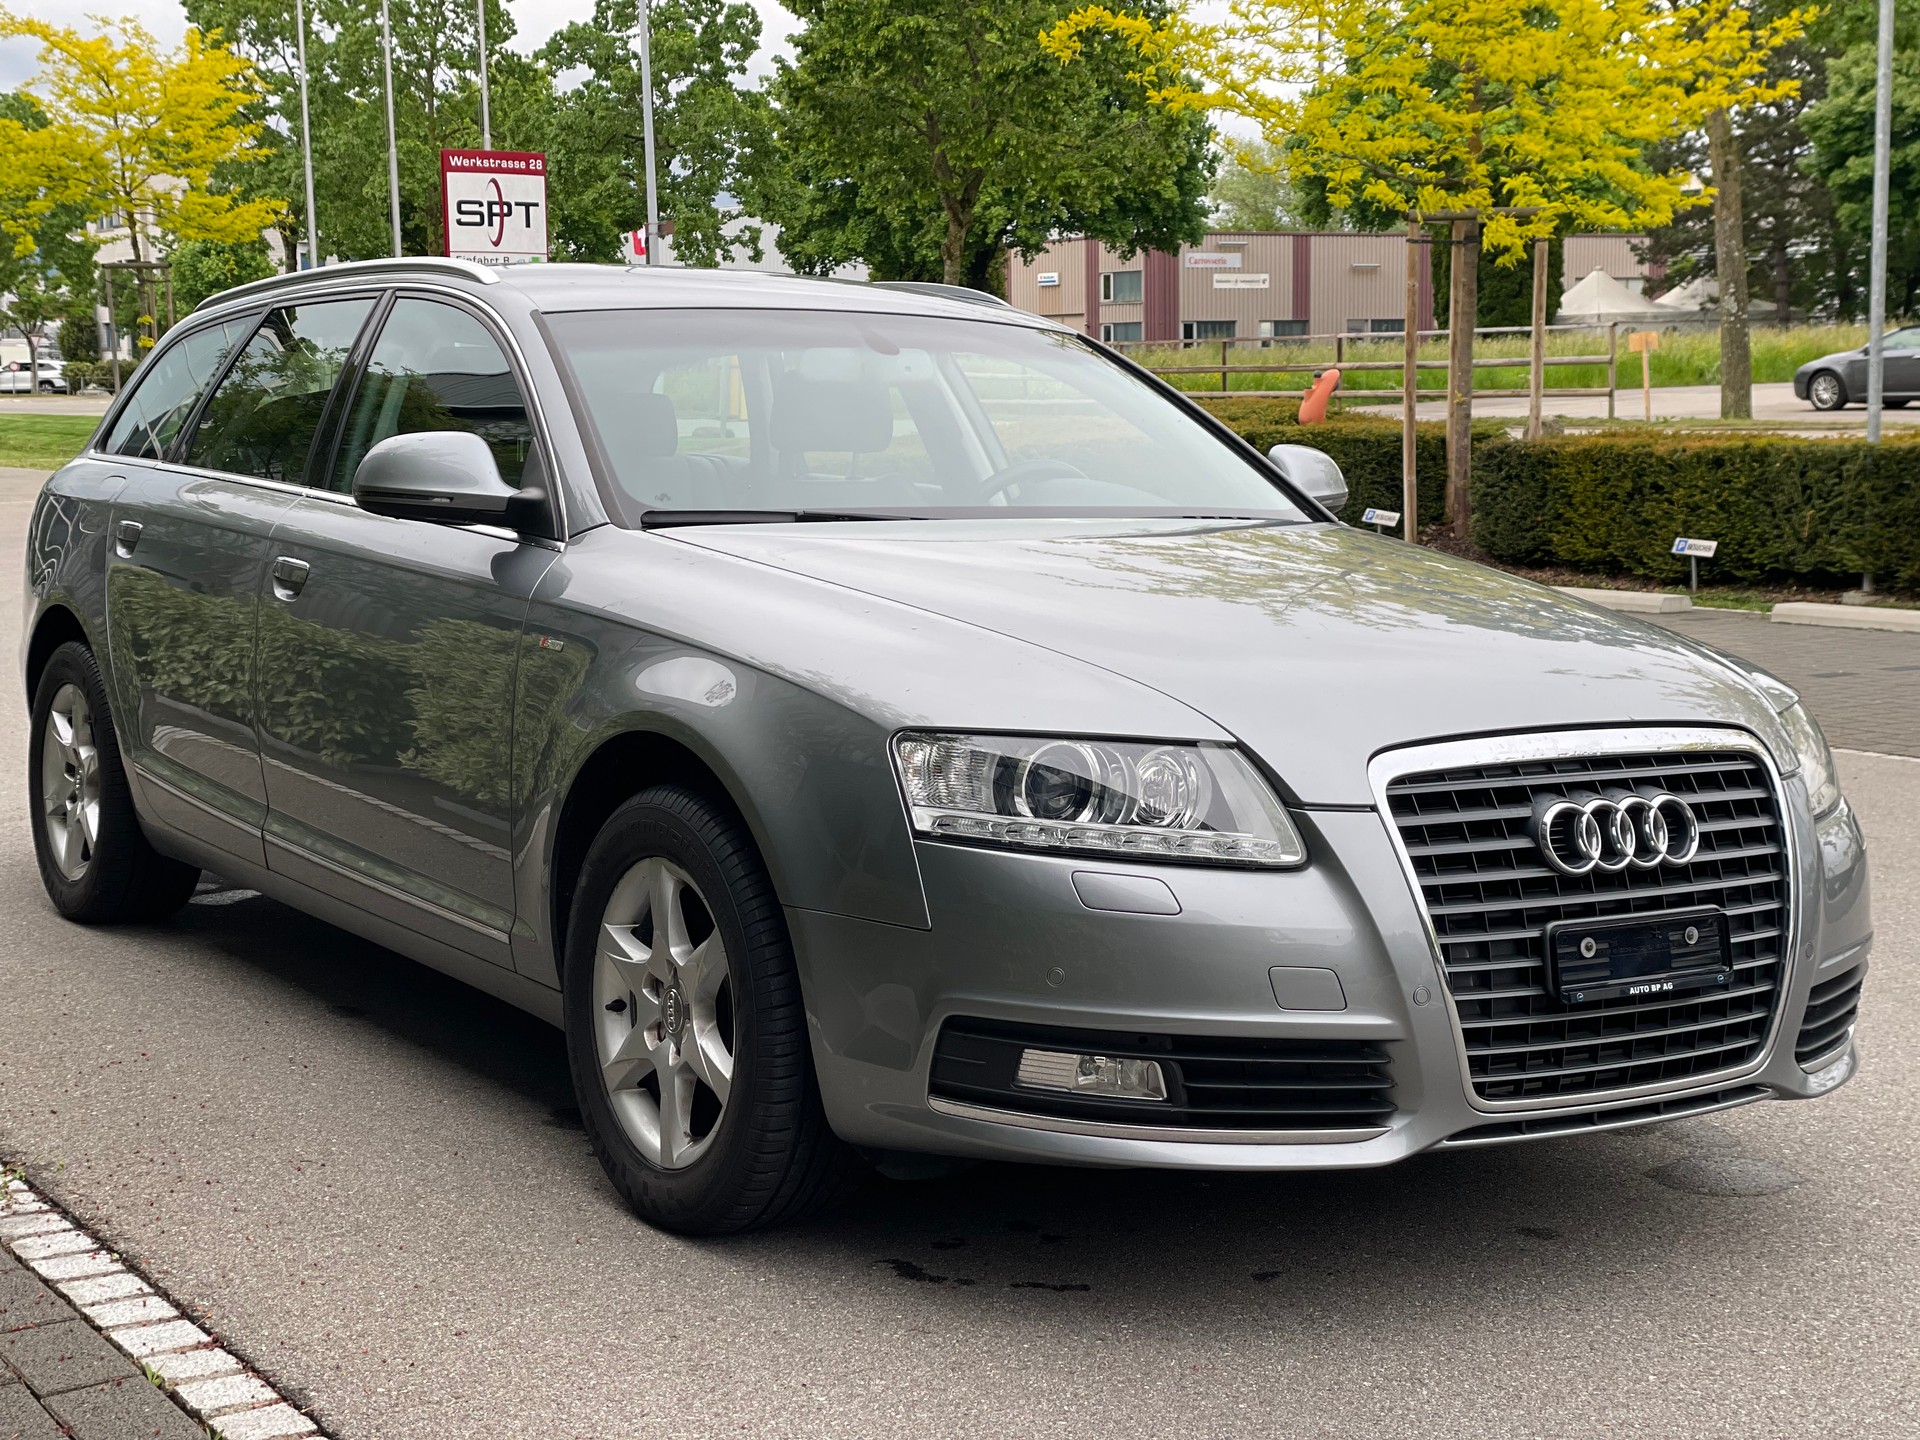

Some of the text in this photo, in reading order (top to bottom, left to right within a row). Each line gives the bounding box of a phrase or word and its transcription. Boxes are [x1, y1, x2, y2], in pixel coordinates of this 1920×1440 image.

[449, 155, 543, 170] Werkstrasse 28
[456, 199, 539, 228] SPT
[456, 255, 499, 264] fahrt
[1630, 982, 1673, 994] AUTO BP AG
